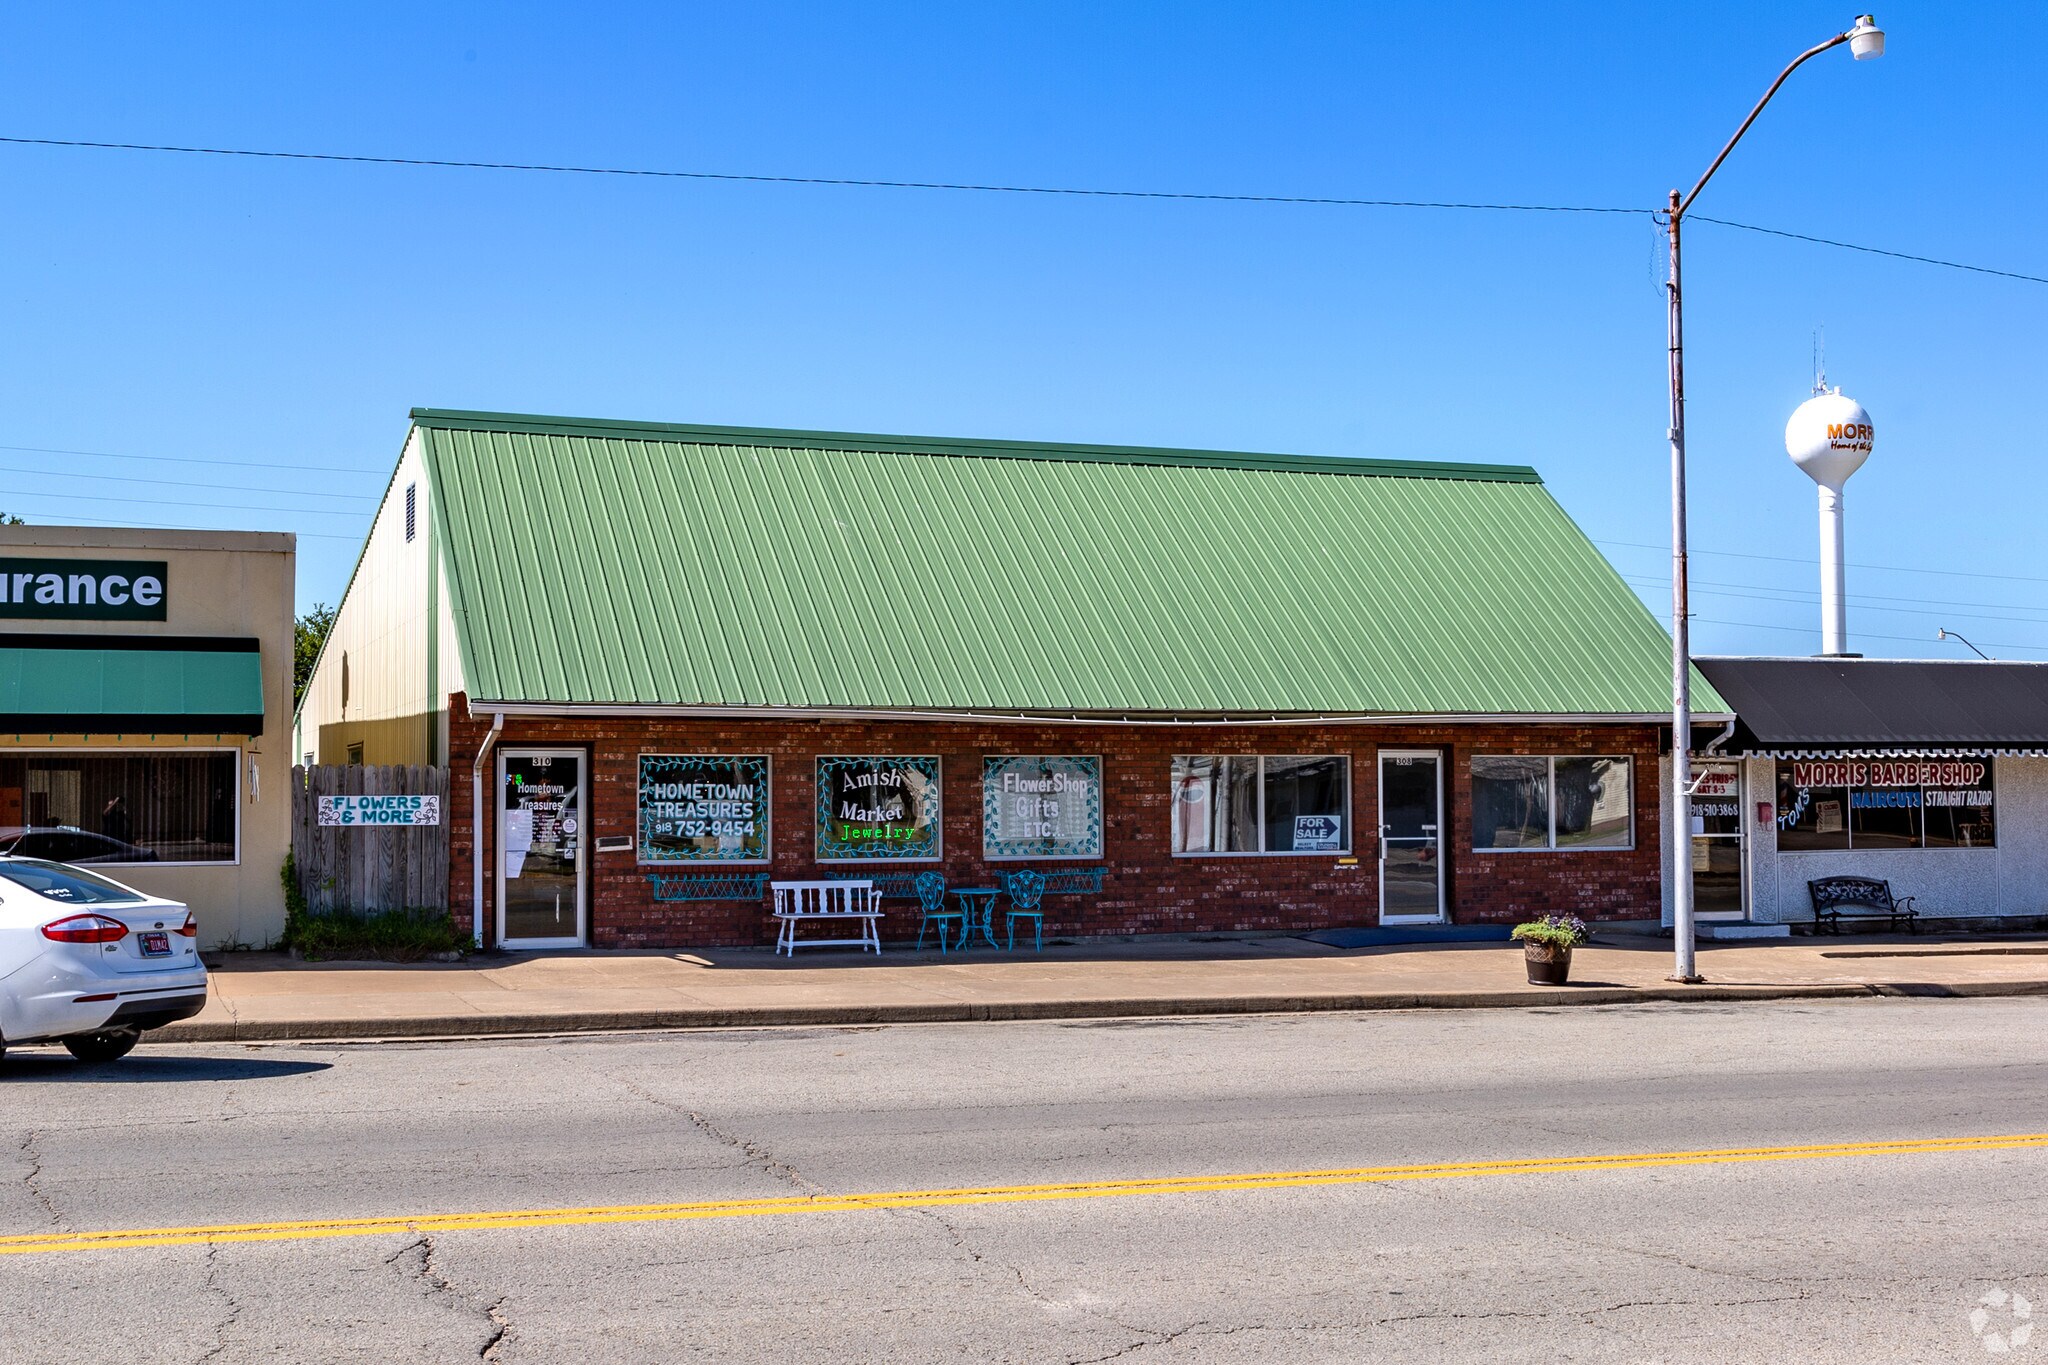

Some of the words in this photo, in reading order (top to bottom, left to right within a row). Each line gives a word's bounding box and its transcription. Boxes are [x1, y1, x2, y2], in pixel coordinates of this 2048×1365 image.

[0, 573, 162, 606] rance
[533, 757, 551, 765] 310
[842, 768, 901, 792] Amish
[1794, 762, 1867, 787] MORRIS
[517, 782, 564, 793] Hometown
[654, 783, 754, 800] HOMETOWN
[333, 796, 422, 810] FLOWERS
[518, 799, 563, 811] Treasures
[1851, 791, 1921, 808] HAIRCUTS
[1925, 790, 1967, 807] STRAIGHT
[1966, 790, 1993, 806] RAZOR
[654, 802, 754, 818] TREASURES
[840, 800, 903, 822] Market
[1016, 796, 1059, 818] Gifts
[1690, 803, 1739, 816] 918-510-3868
[341, 810, 355, 824] &
[361, 810, 415, 824] MORE
[1299, 818, 1325, 827] FOR
[655, 822, 672, 833] 918
[675, 821, 755, 837] 752-9454
[841, 824, 915, 841] Jewelry
[1296, 829, 1328, 838] SALE
